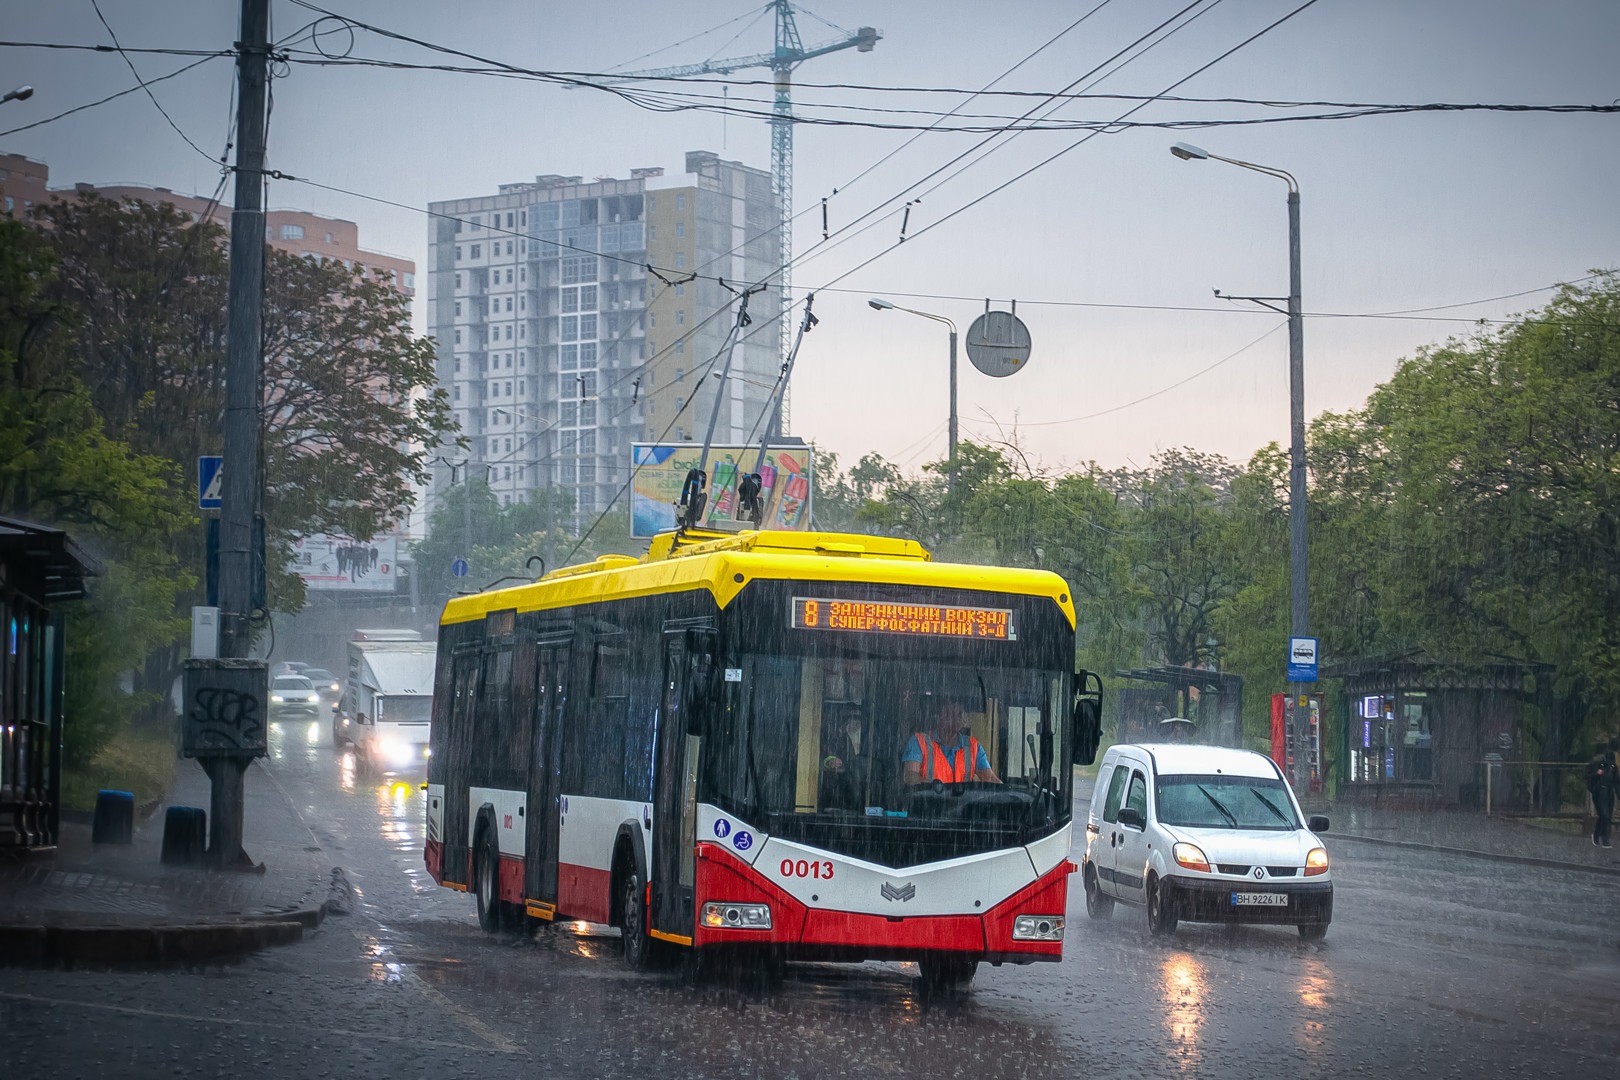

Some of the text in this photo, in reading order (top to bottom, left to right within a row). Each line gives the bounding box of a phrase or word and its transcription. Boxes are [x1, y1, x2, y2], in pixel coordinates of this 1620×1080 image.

[804, 600, 1006, 627] 8 ЗАЛІЗНИЧНИЙ ВОКЗАЛ
[829, 615, 972, 635] СУПЕРФОСФАТНИЙ
[780, 858, 834, 880] 0013
[1252, 895, 1273, 905] 9226
